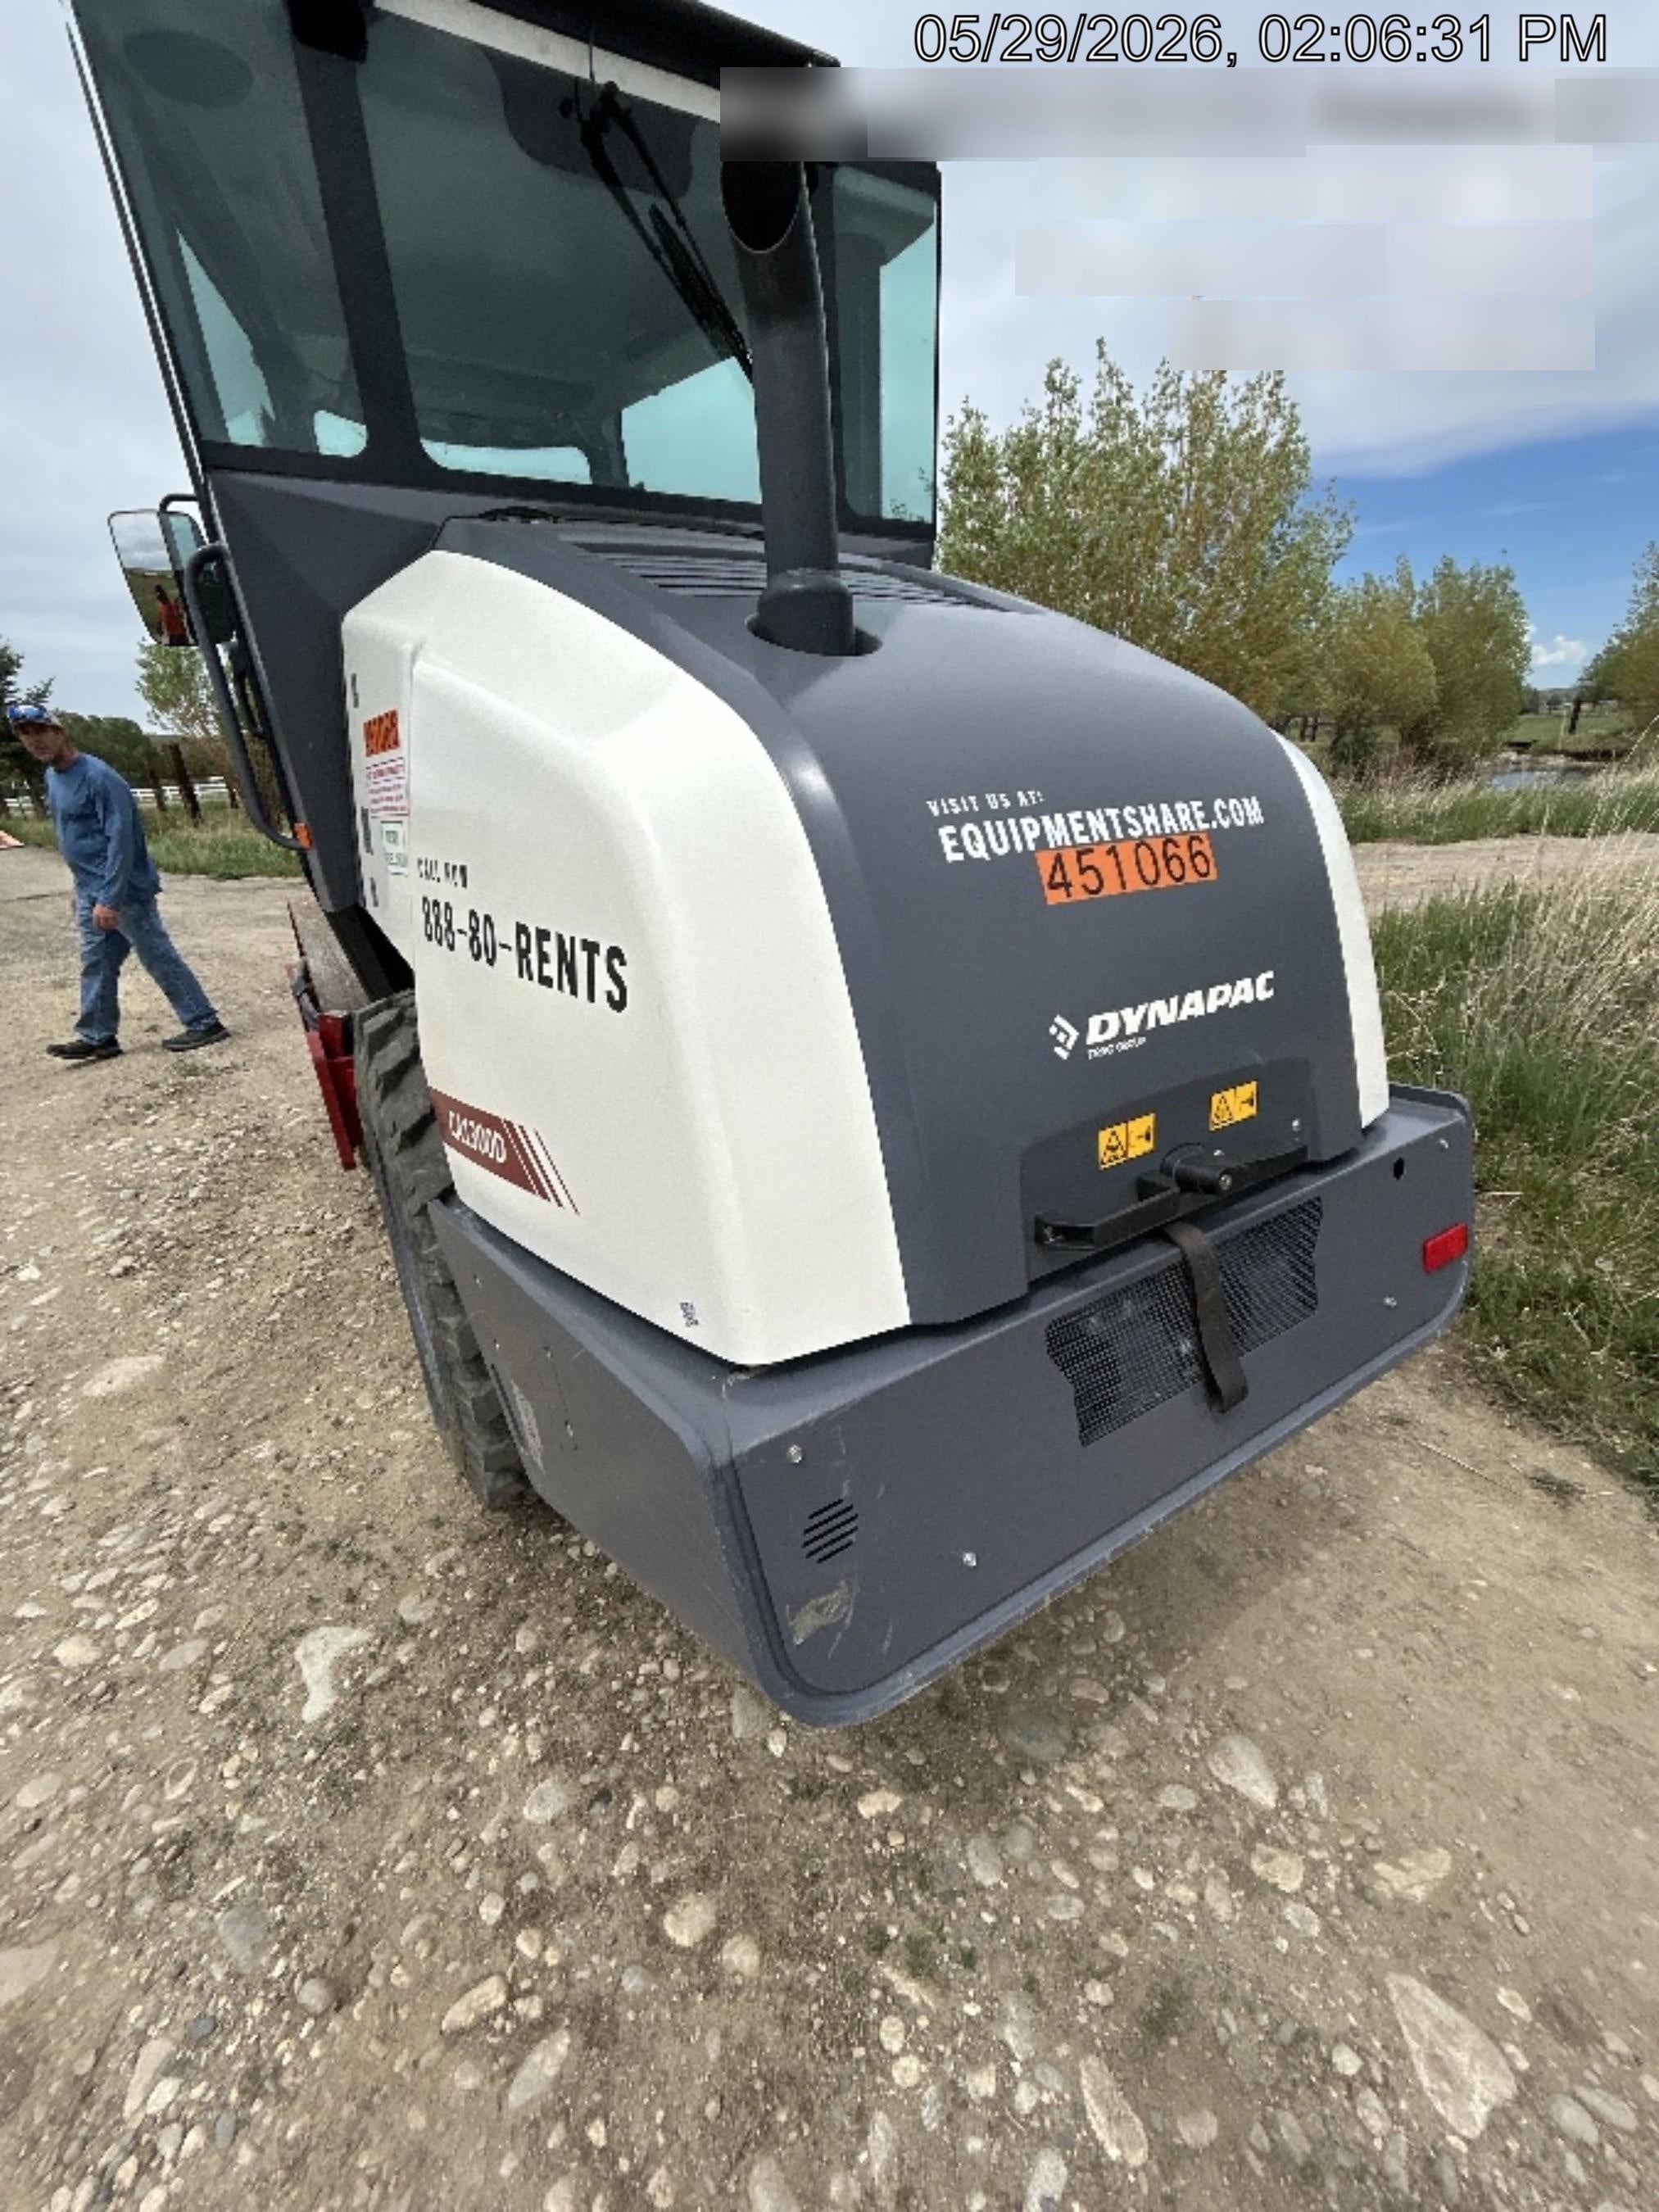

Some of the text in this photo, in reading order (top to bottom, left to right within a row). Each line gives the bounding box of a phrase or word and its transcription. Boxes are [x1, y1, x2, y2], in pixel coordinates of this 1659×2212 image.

[926, 790, 1045, 817] VISIT US AT:
[938, 796, 1265, 863] EQUIPMENTSHARE.COM
[1047, 834, 1213, 899] 451066
[421, 895, 628, 1013] 888-80-RENTS
[1086, 970, 1275, 1045] DYNAPAC
